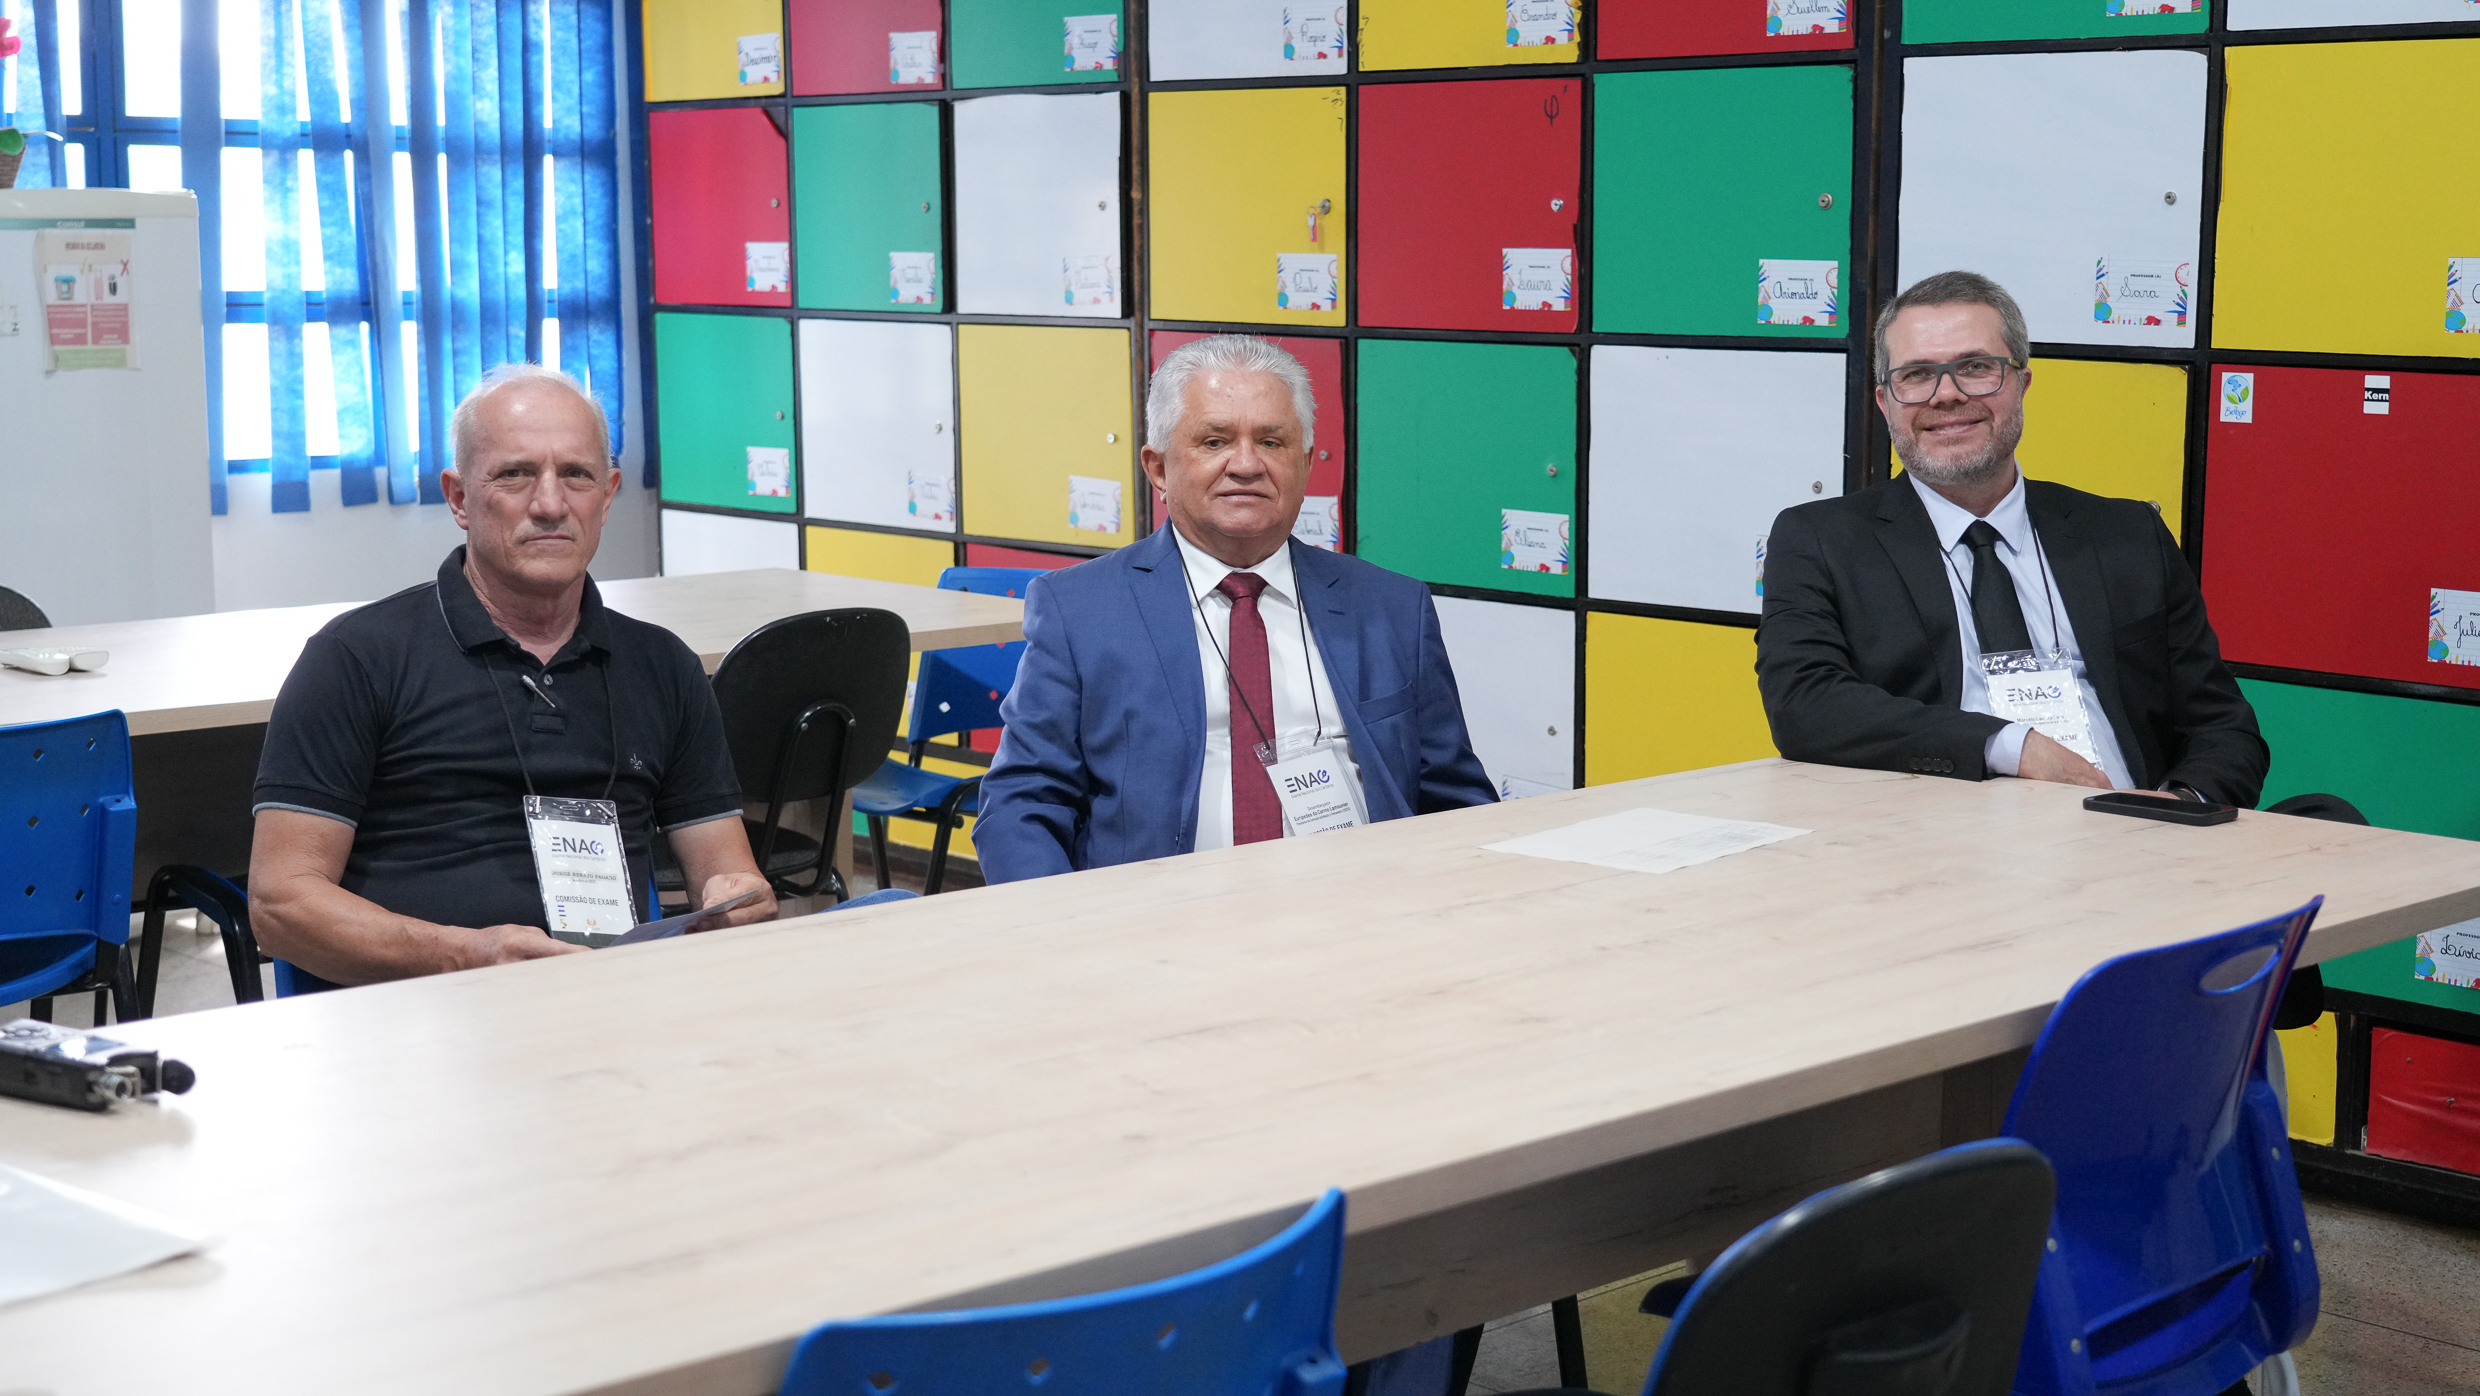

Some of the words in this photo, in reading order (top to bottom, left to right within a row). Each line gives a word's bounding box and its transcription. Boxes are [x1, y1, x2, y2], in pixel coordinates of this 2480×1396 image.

[1517, 269, 1554, 291] Laura
[2116, 276, 2160, 302] Sara
[2364, 391, 2389, 401] Kern
[2453, 615, 2480, 649] Juli
[1284, 769, 1331, 793] ENAC
[550, 837, 604, 855] ENAC
[556, 895, 587, 904] COMISSÃO
[597, 898, 619, 907] EXAME
